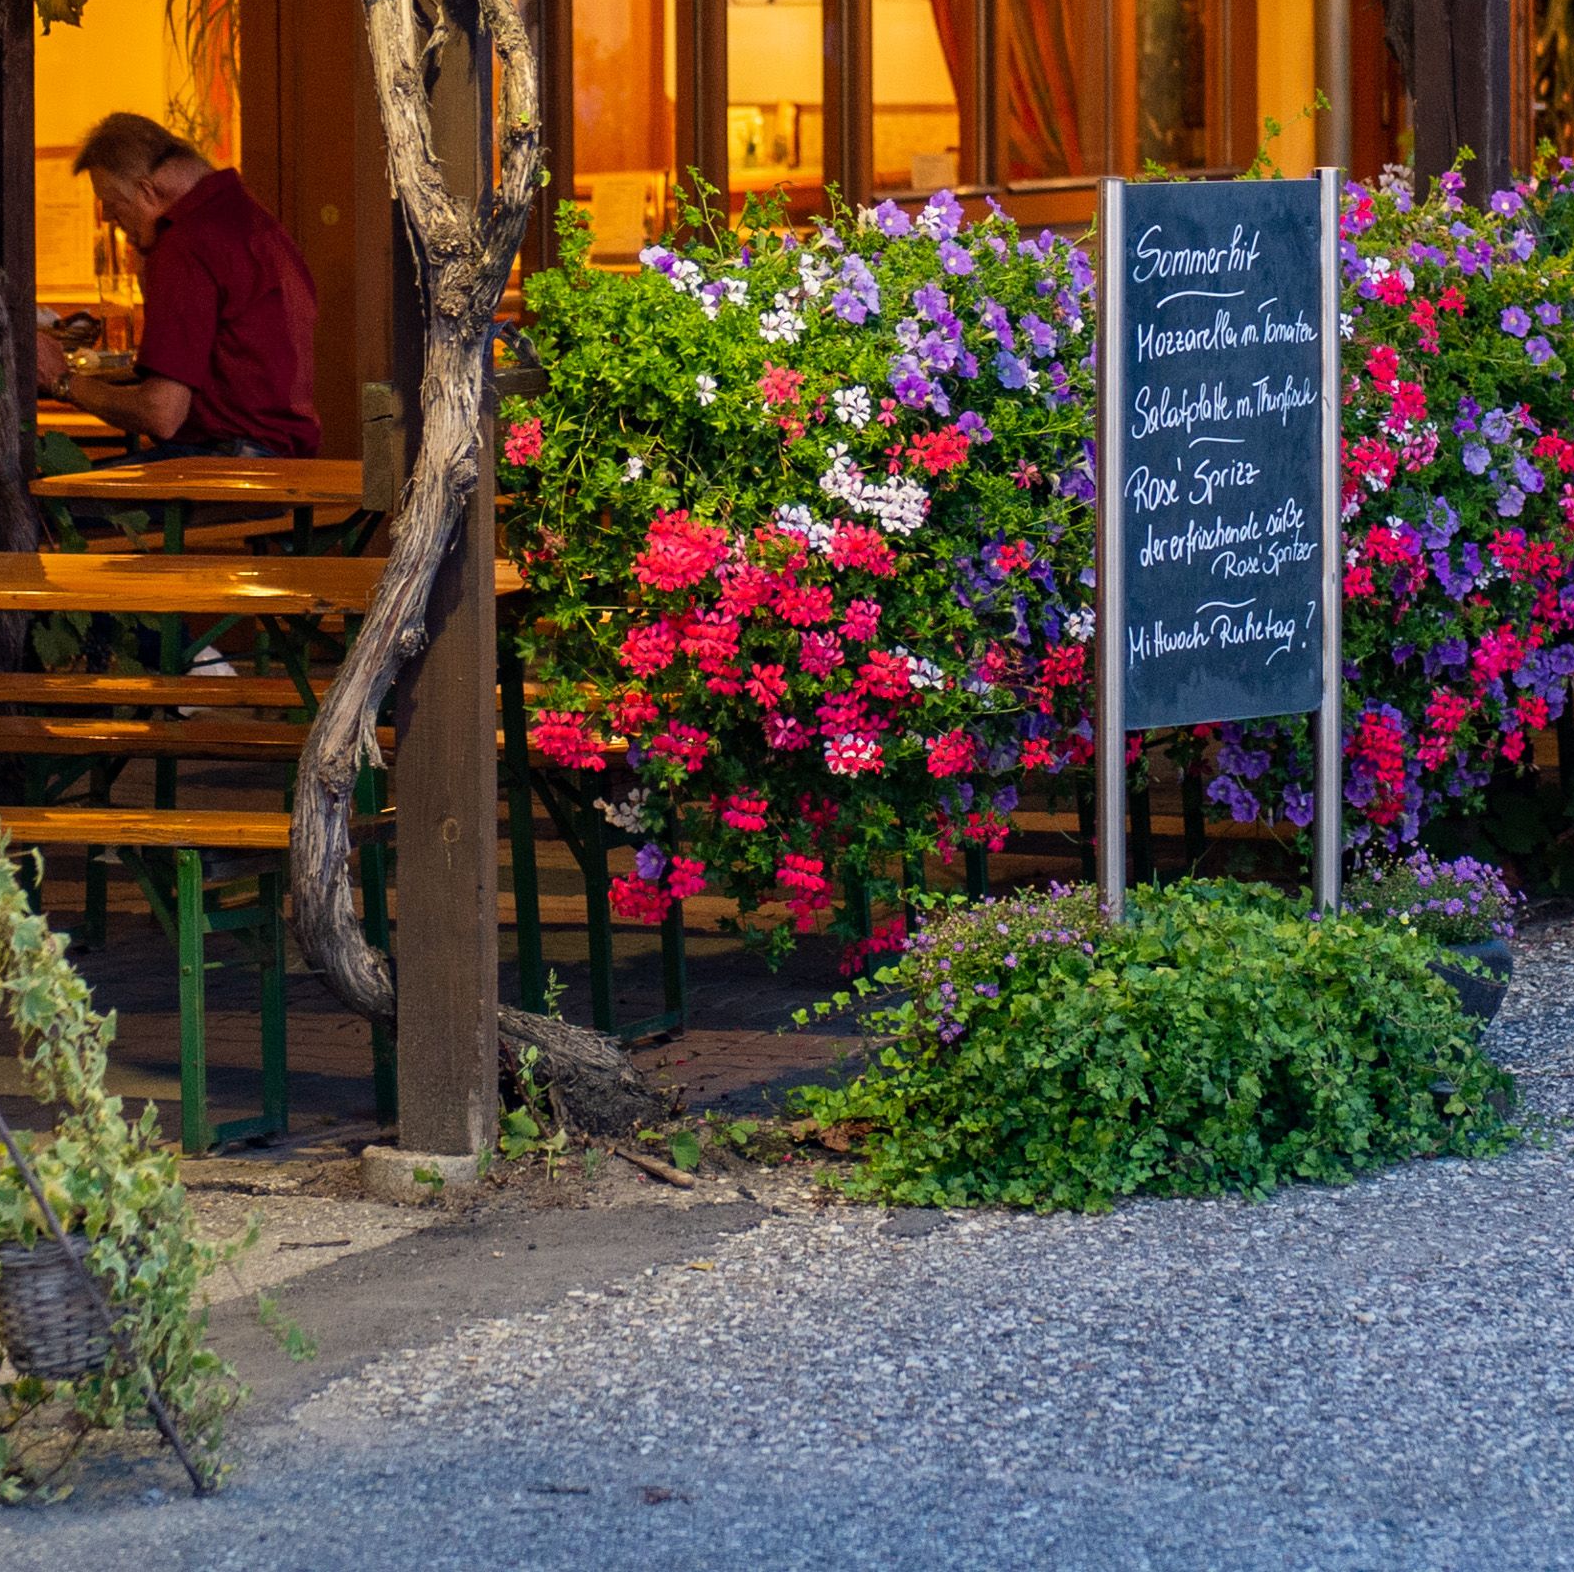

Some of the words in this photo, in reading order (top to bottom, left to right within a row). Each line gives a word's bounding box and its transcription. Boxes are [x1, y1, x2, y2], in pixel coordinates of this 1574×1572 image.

[1133, 224, 1260, 283] Sommerhit
[1137, 309, 1238, 363] Mozzarella
[1258, 297, 1318, 349] Tomaten
[1131, 381, 1232, 439] Salatplatte
[1252, 374, 1317, 427] Thunfisch
[1188, 459, 1260, 505] Sprizz
[1140, 524, 1168, 567] der
[1170, 511, 1262, 565] erfrischende
[1262, 531, 1318, 577] Spritzer
[1128, 620, 1210, 667] Mittwoch
